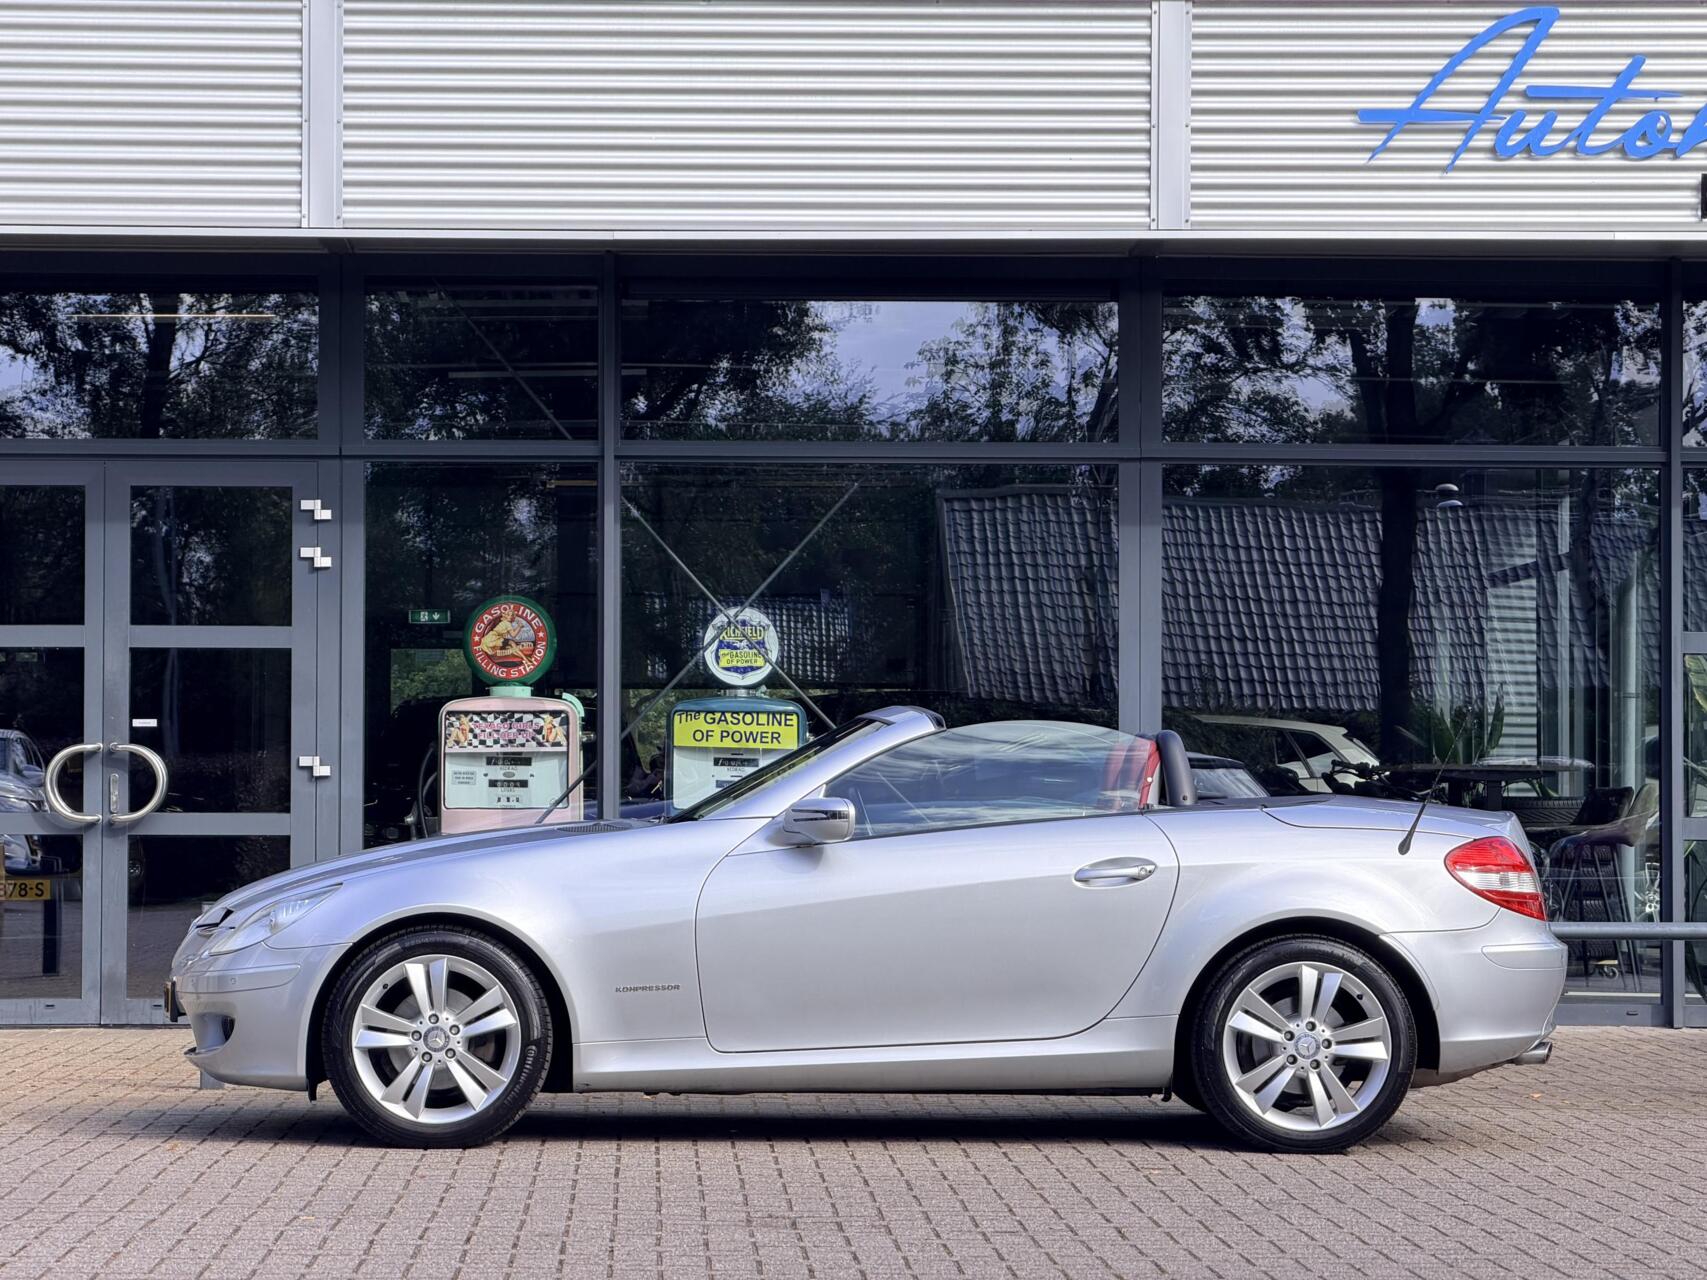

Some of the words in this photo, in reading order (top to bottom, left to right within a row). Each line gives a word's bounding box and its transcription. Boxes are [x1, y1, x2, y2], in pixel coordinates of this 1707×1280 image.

[475, 604, 542, 633] GASOLINE
[473, 645, 507, 677] FILLING
[511, 641, 546, 677] STATION
[677, 711, 701, 724] The
[703, 711, 795, 727] GASOLINE
[692, 729, 715, 742] OF
[719, 730, 782, 744] POWER
[615, 984, 681, 993] KOMPRESSOR
